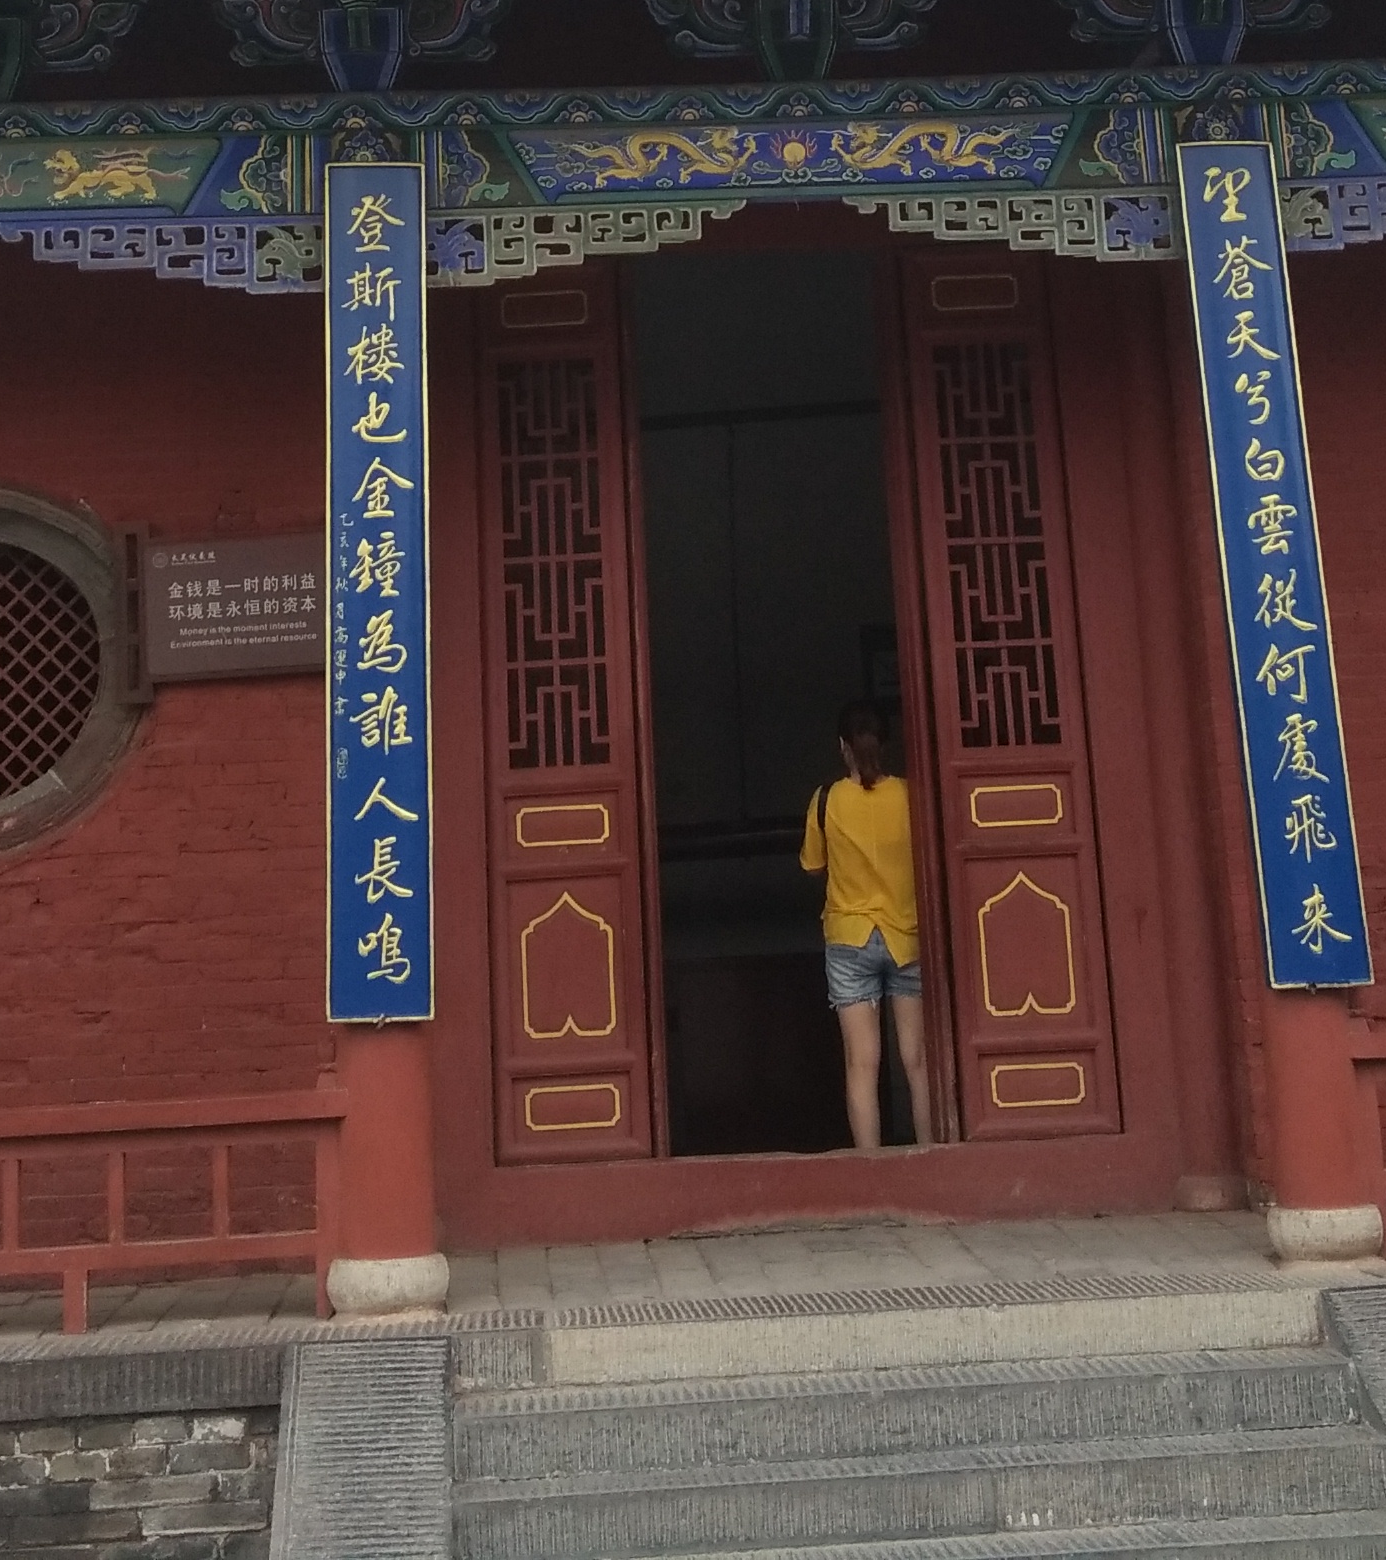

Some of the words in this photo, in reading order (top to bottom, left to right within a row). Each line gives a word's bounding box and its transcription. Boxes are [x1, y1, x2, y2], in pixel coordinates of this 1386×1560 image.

[168, 573, 317, 599] 金钱是一时的利益
[168, 595, 317, 621] 环境是永恒的资本
[179, 627, 208, 637] Money
[218, 625, 231, 633] the
[234, 637, 247, 645] the
